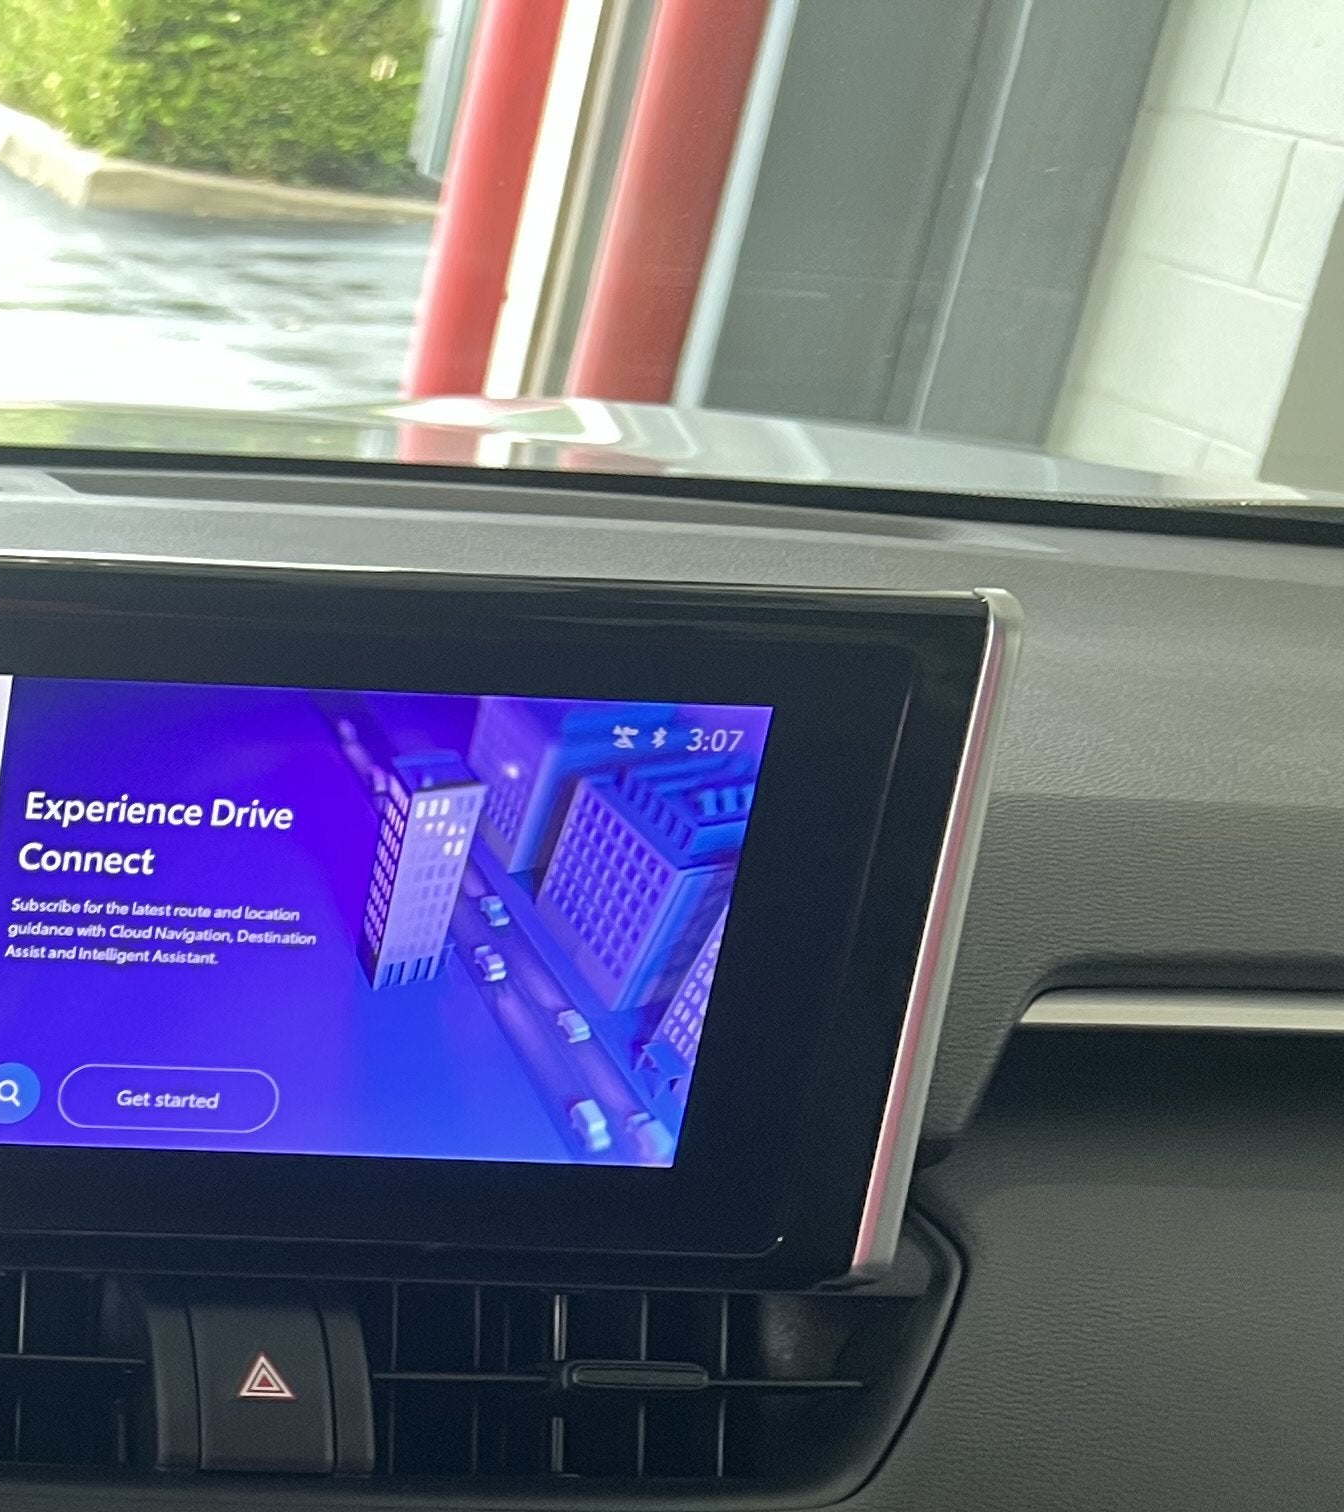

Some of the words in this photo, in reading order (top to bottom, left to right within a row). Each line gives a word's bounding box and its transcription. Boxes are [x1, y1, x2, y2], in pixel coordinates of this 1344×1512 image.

[686, 728, 745, 752] 3:07
[25, 791, 203, 828] Experience
[210, 798, 294, 830] Drive
[18, 842, 156, 876] Connect
[11, 897, 81, 914] Subscribe
[83, 899, 104, 914] for
[106, 901, 129, 915] the
[132, 902, 172, 917] latest
[173, 905, 211, 919] route
[214, 905, 242, 920] and
[244, 906, 300, 922] location
[7, 922, 74, 938] guidance
[77, 924, 106, 938] with
[109, 925, 153, 939] Cloud
[155, 927, 234, 944] Navigation,
[237, 929, 317, 946] Destination
[5, 944, 46, 959] Assist
[47, 945, 77, 960] and
[78, 947, 150, 965] Intelligent
[152, 949, 218, 966] Assistant.
[117, 1089, 151, 1107] Get
[154, 1092, 220, 1110] started
